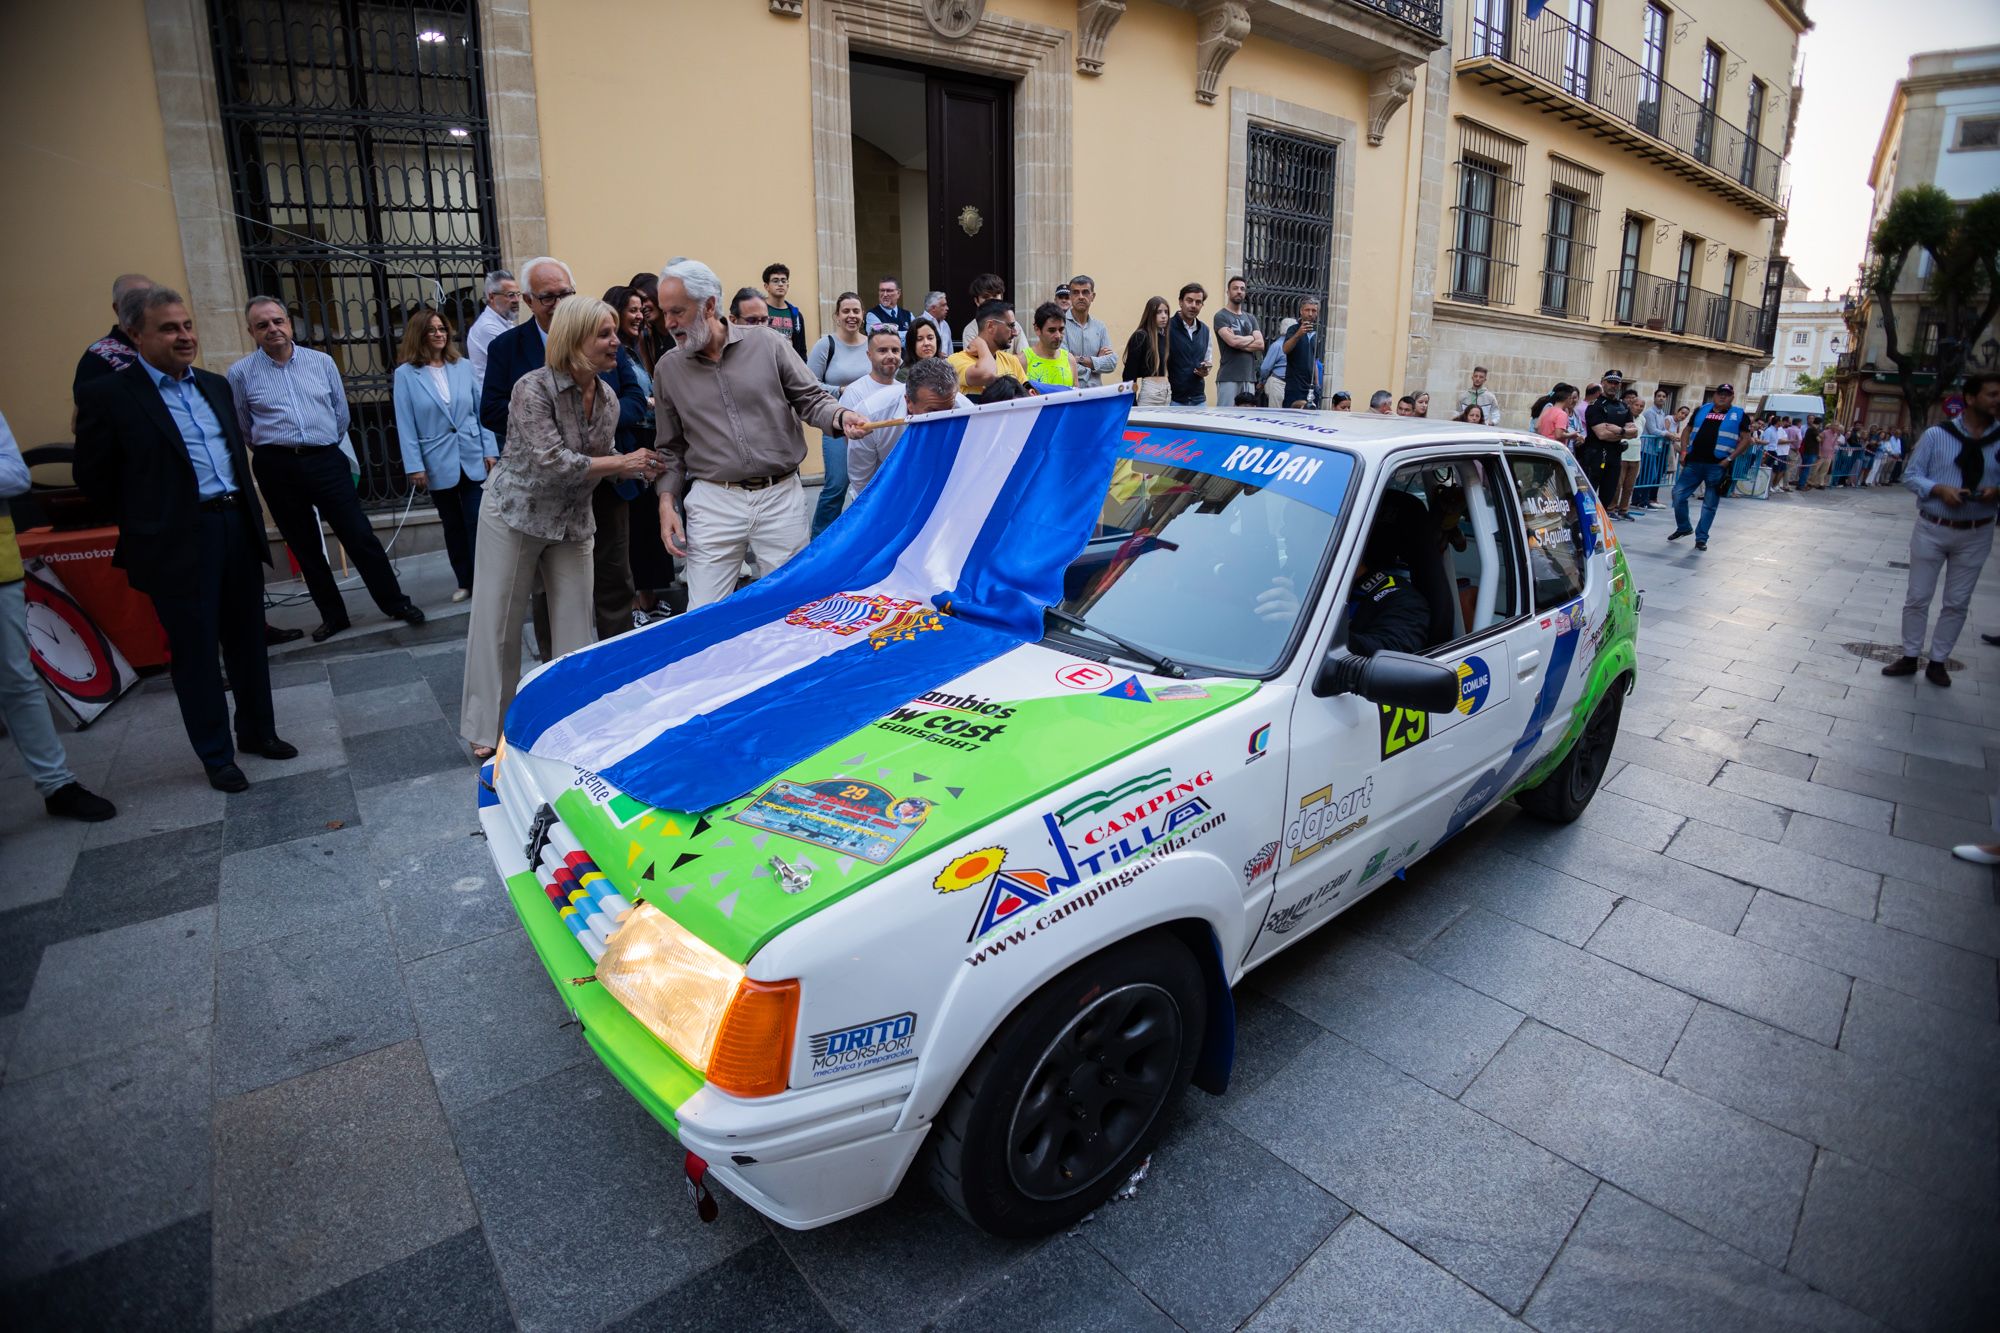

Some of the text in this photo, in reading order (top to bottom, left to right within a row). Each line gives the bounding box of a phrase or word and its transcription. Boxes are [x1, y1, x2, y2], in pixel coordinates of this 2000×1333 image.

[1248, 417, 1339, 434] RACING
[1221, 444, 1324, 485] ROLDAN
[1535, 526, 1571, 549] S.Aguilar
[41, 548, 115, 563] otomotor
[1462, 674, 1488, 695] COMLINE
[917, 691, 1017, 719] ambios
[923, 715, 1008, 742] cost
[1383, 704, 1426, 755] 29
[839, 785, 869, 800] 29
[1084, 770, 1214, 845] CAMPING
[1286, 775, 1374, 849] dapart
[965, 812, 1227, 967] www.campingantilla.com
[826, 1016, 911, 1055] DRITO
[812, 1035, 914, 1071] MOTORSPORT
[813, 1063, 856, 1078] mecánica
[863, 1048, 913, 1068] preparación
